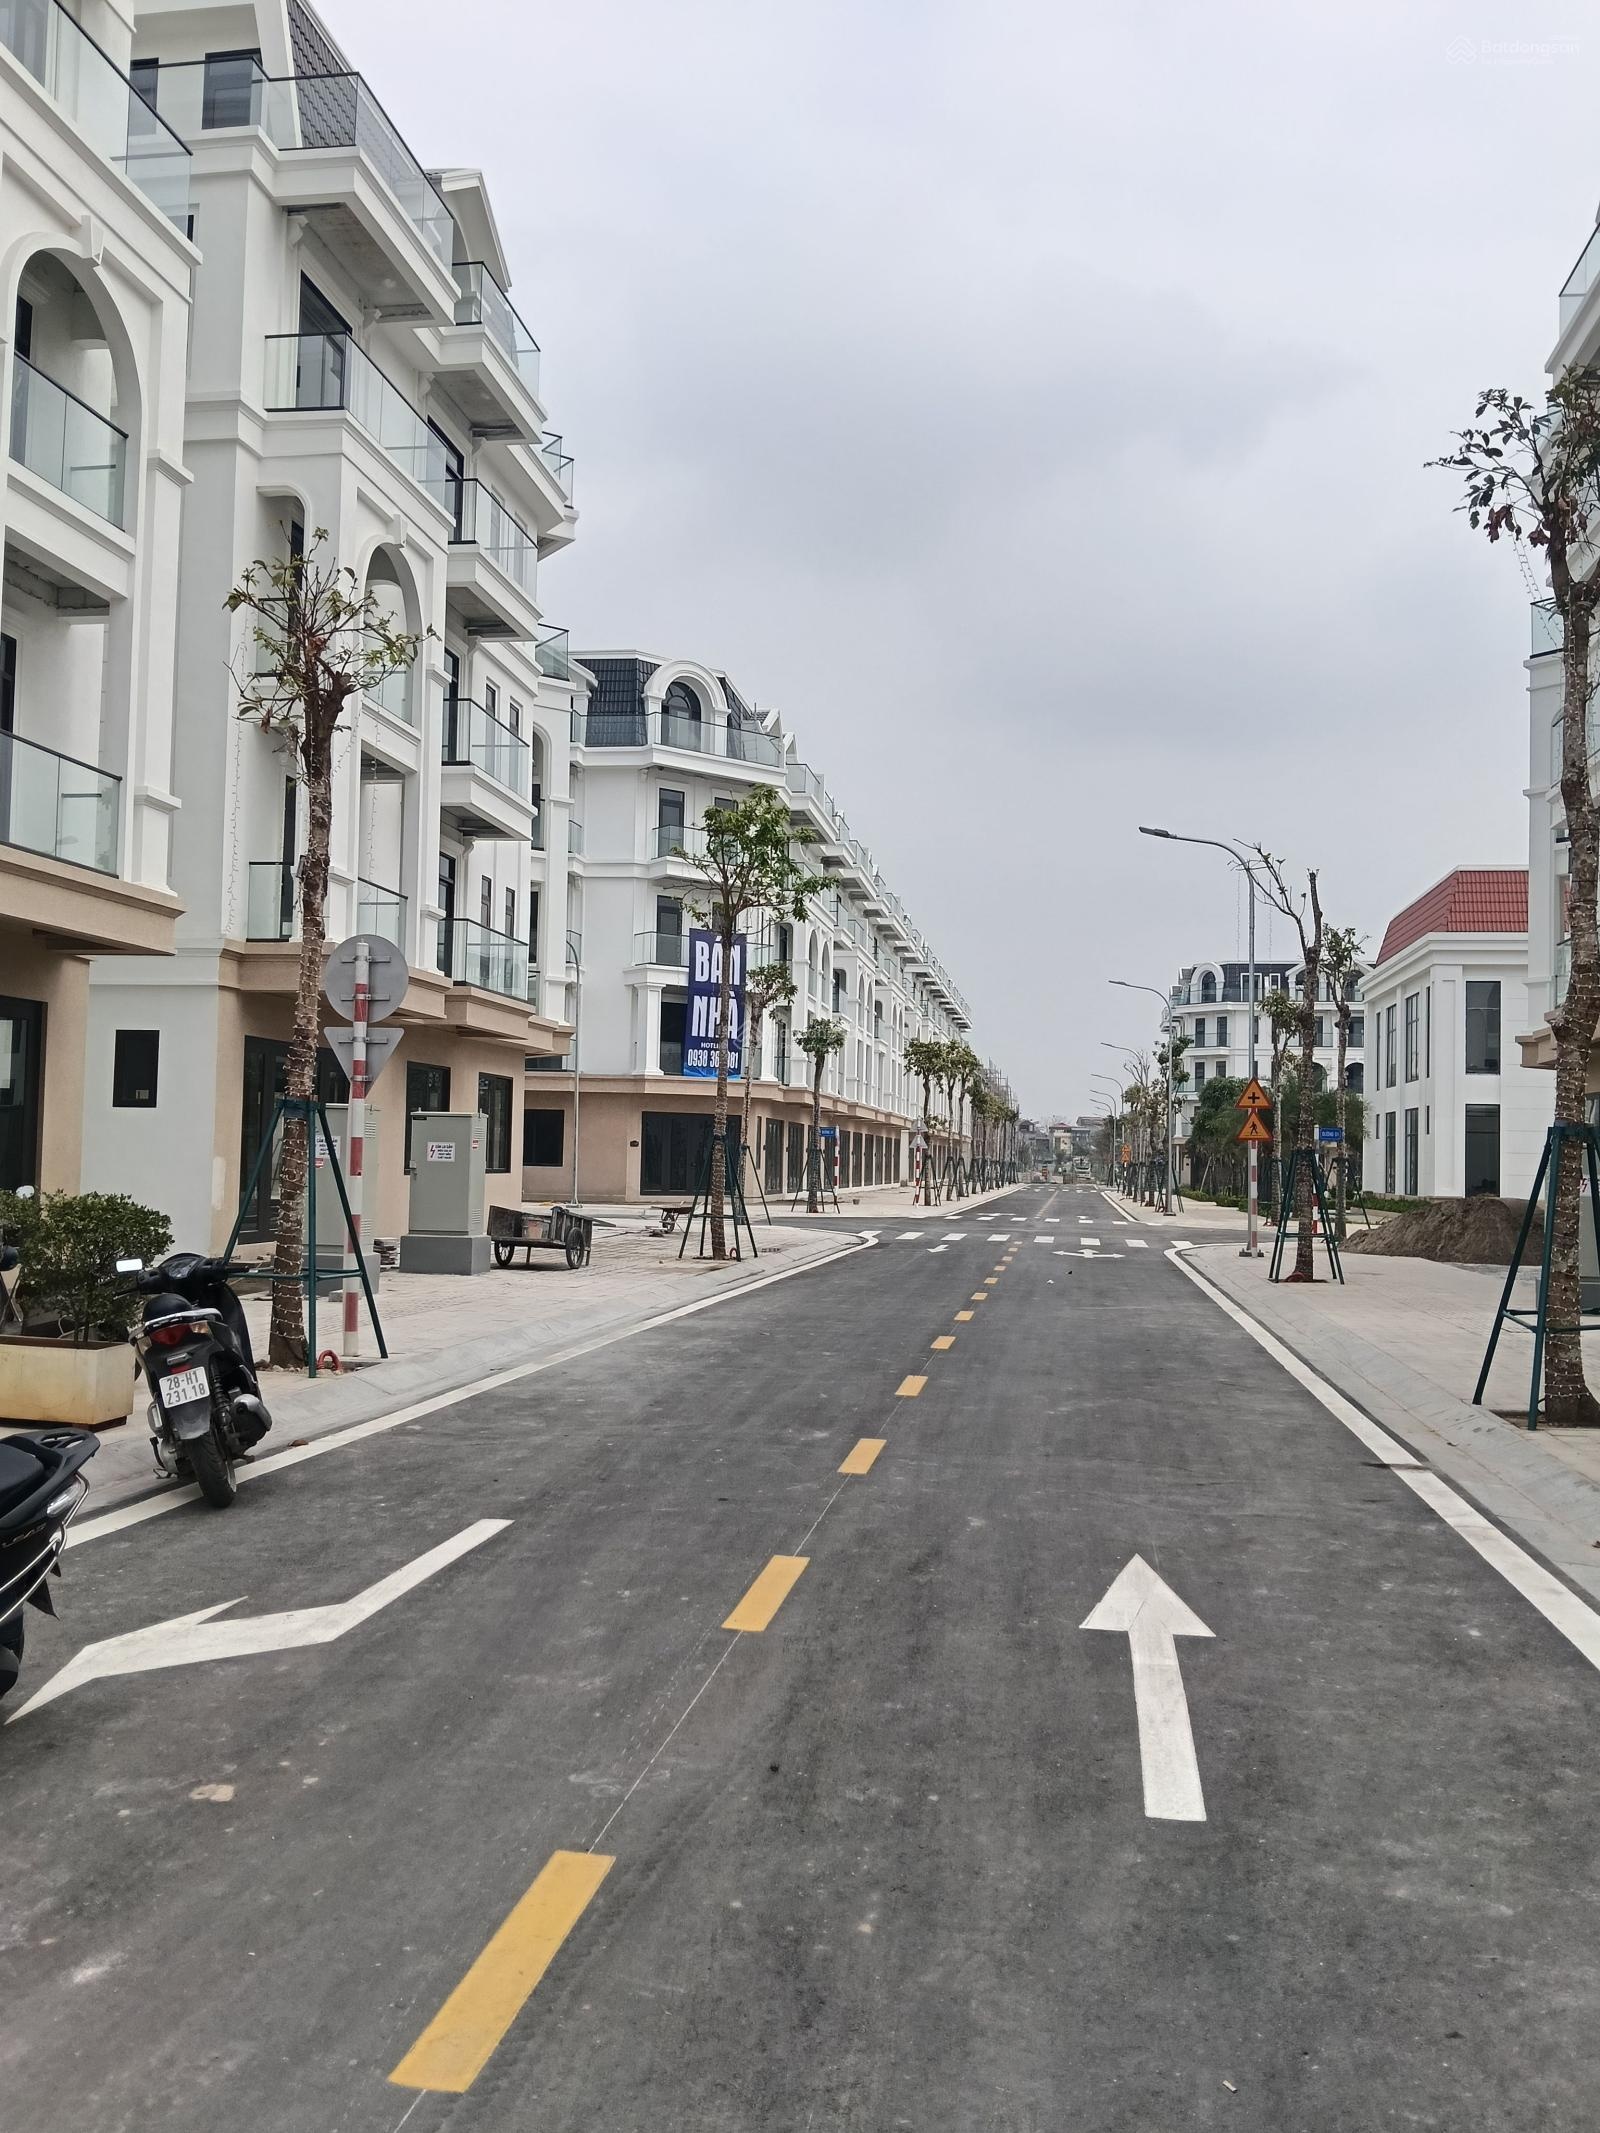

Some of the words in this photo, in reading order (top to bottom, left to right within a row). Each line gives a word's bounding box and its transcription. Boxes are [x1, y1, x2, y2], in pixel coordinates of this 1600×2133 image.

[695, 936, 741, 986] BÁN
[691, 990, 739, 1040] NHÀ
[687, 1048, 708, 1067] 0938
[709, 1049, 720, 1068] 36
[167, 1370, 199, 1391] 28-H1
[166, 1383, 206, 1405] 231.18
